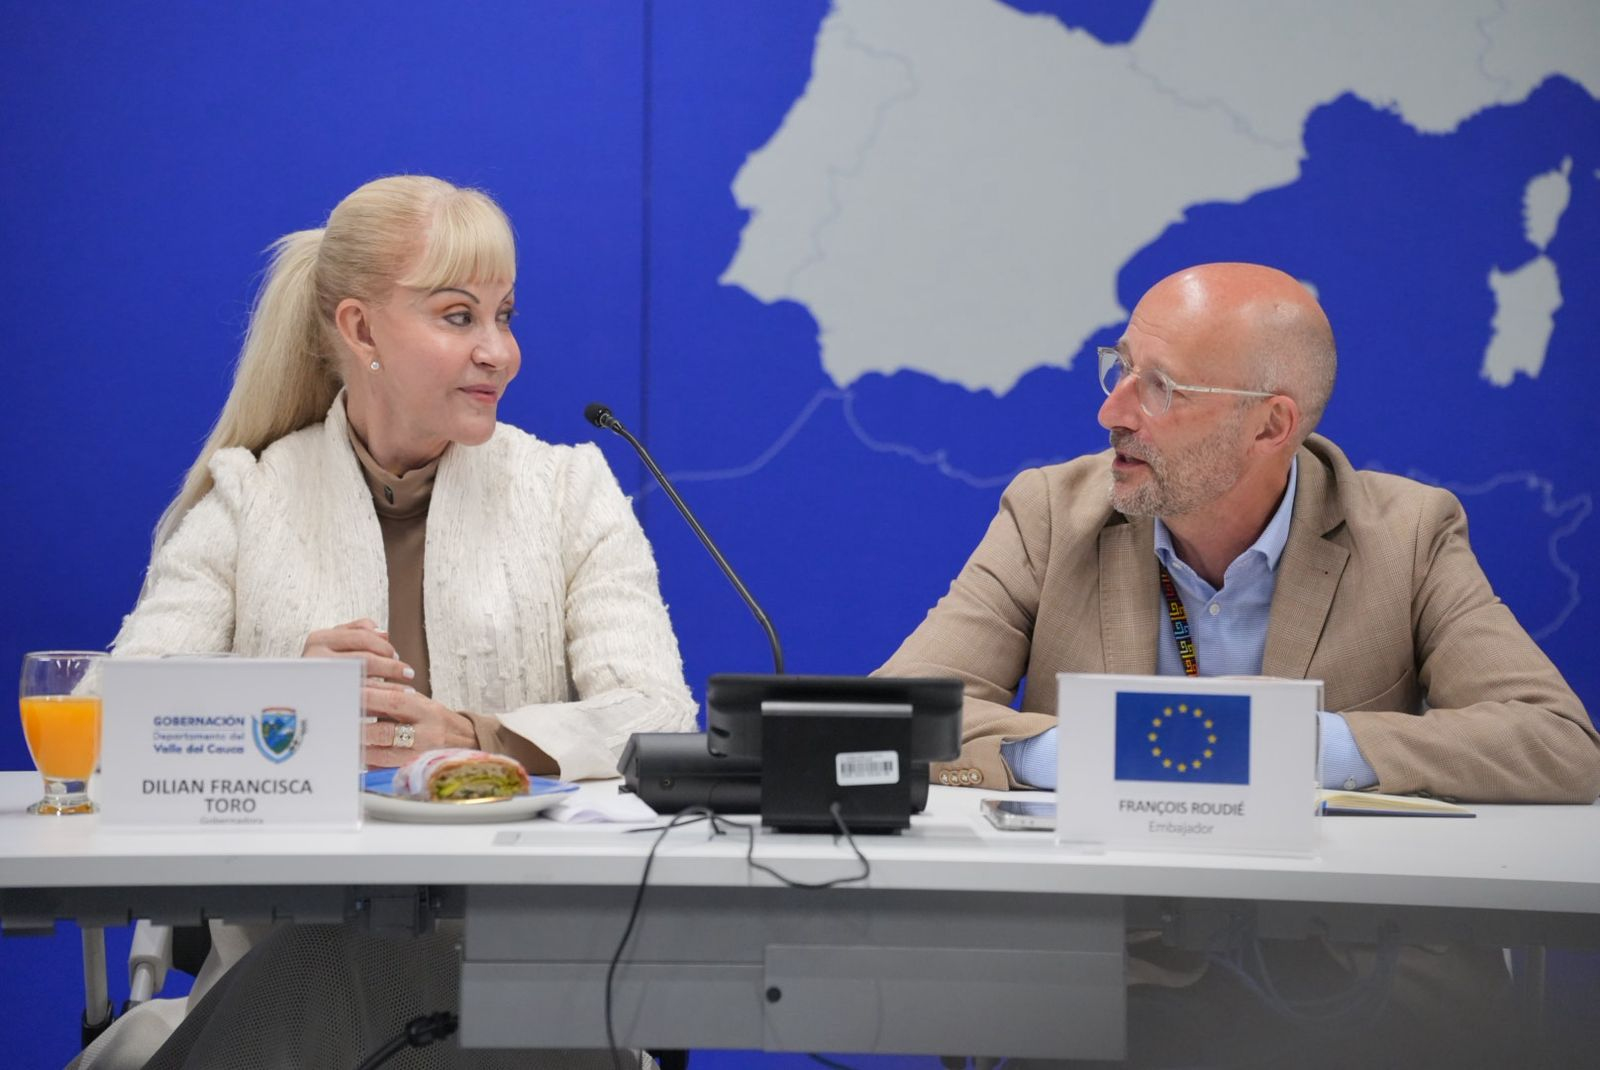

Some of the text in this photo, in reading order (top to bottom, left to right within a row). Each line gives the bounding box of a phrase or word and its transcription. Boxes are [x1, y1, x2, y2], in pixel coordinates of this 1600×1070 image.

[153, 714, 245, 726] GOBERNACIÓN
[153, 731, 245, 742] Departamento del
[153, 744, 244, 754] Valle del Cauca
[142, 779, 313, 794] DILIAN FRANCISCA
[204, 798, 256, 813] TORO
[1119, 799, 1245, 816] FRANÇOIS ROUDIÉ
[200, 816, 263, 825] Gobernadora
[1148, 820, 1215, 836] Embajador
